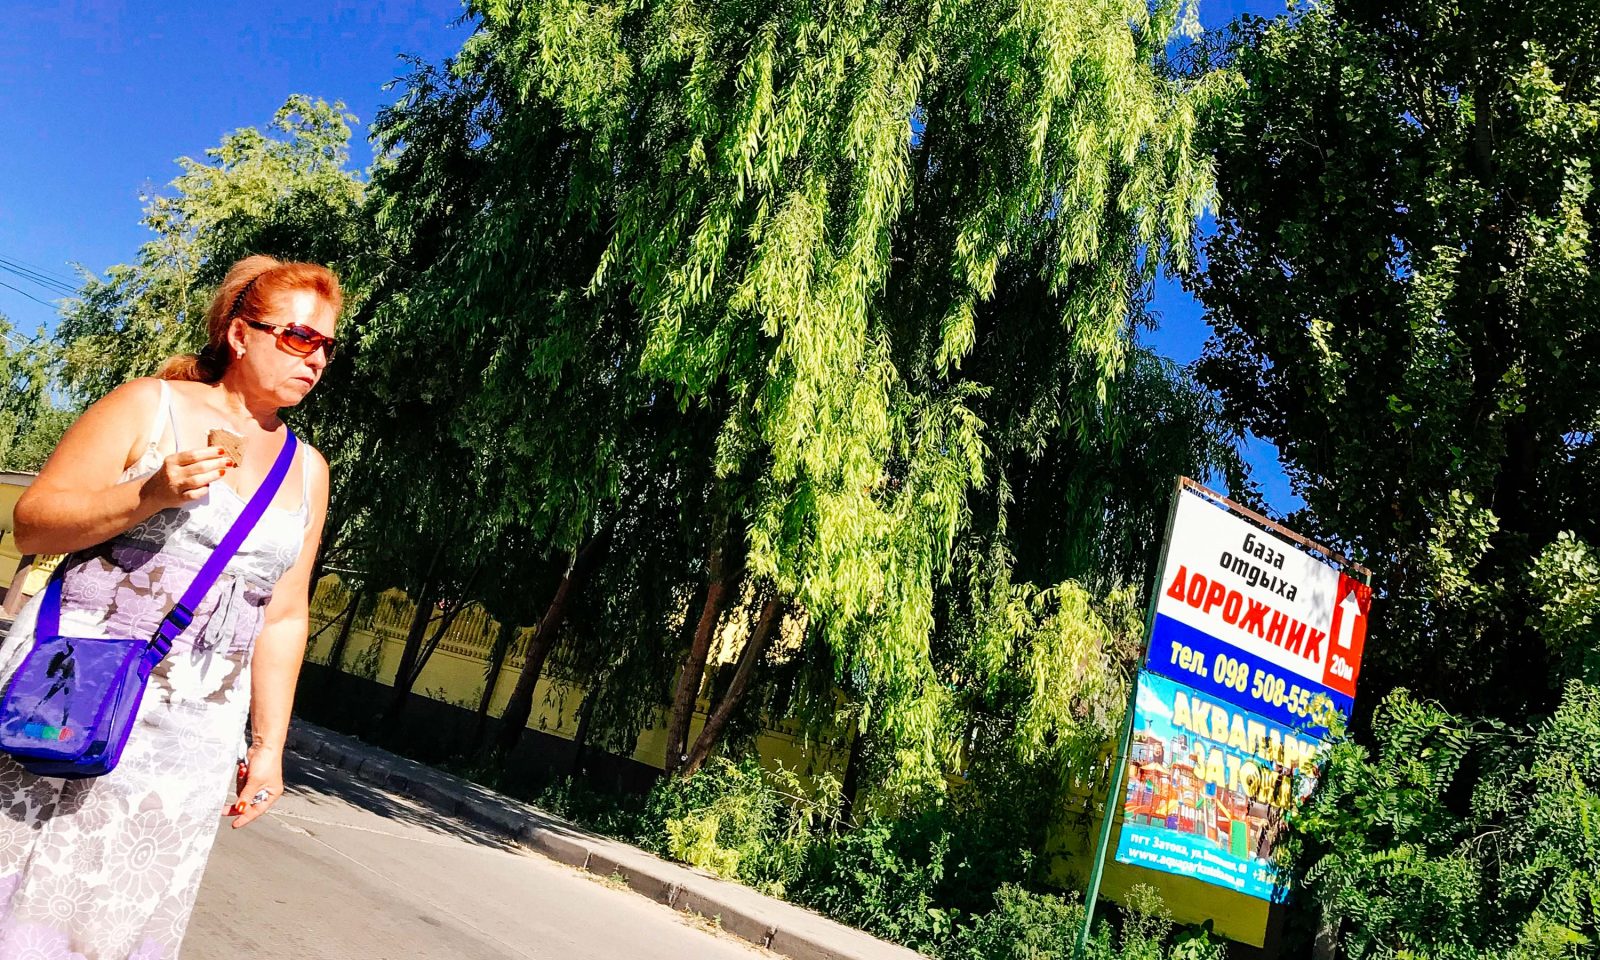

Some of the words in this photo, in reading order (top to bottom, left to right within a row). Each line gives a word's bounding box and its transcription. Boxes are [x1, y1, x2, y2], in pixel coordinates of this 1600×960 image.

[1219, 551, 1298, 602] отдыха
[1242, 532, 1285, 570] база
[1166, 564, 1327, 664] ДОРОЖНИК
[1170, 640, 1208, 678] тел.
[1213, 653, 1250, 693] 098
[1329, 653, 1354, 682] 20м
[1172, 690, 1318, 778] АКВАПАРК
